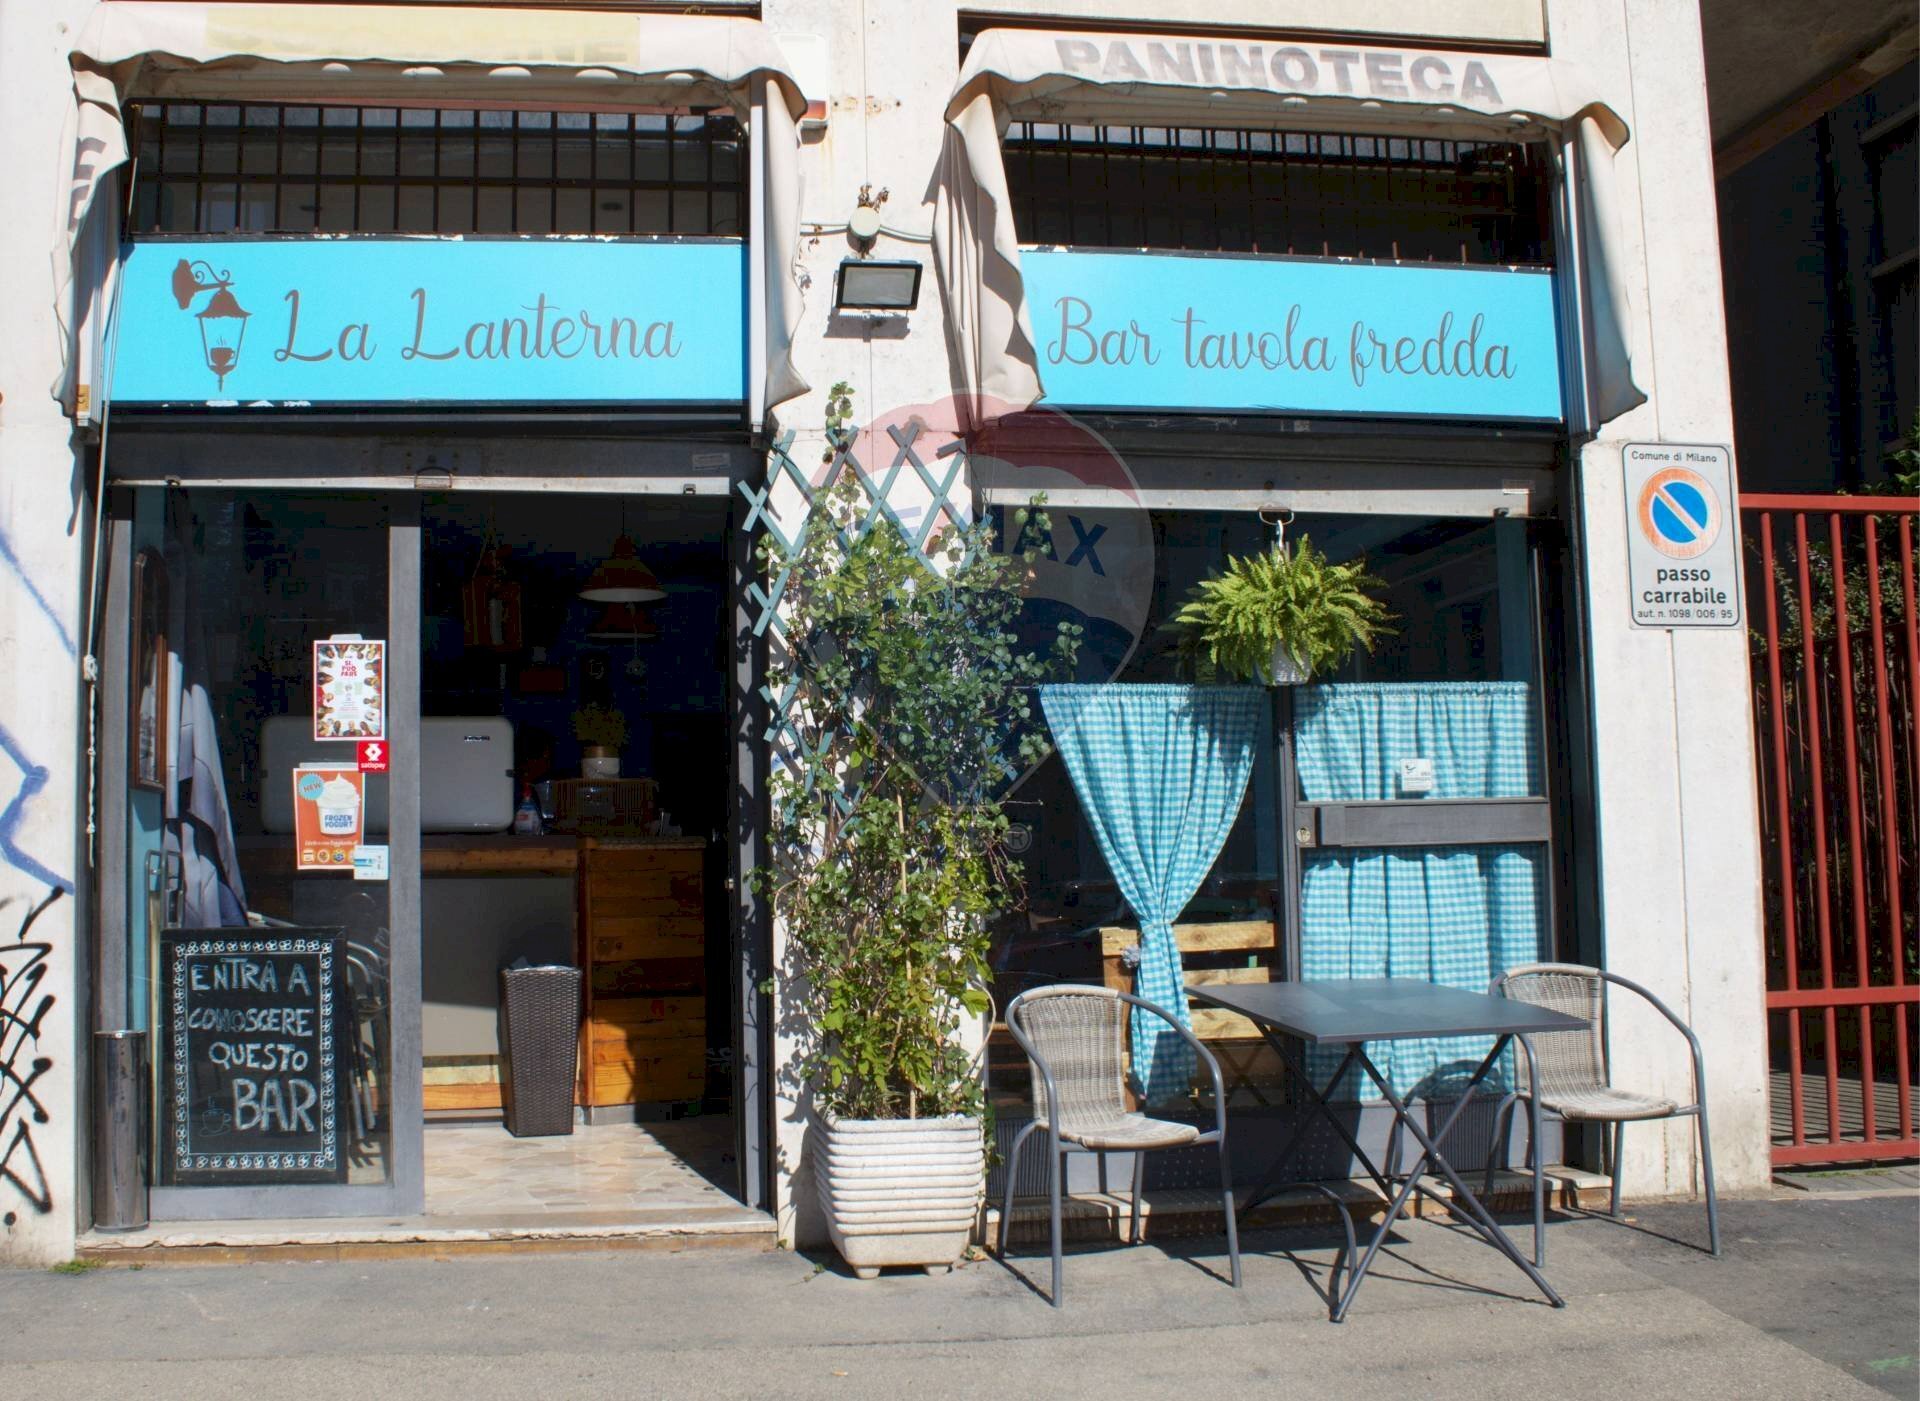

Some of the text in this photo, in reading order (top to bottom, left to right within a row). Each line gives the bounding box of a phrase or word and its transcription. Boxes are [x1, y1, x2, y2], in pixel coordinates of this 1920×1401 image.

[1054, 39, 1503, 104] PANINOTECA
[274, 287, 682, 362] La Lanterna
[1047, 296, 1518, 388] Bar tavola fredda
[1631, 450, 1718, 463] Comune di Milano
[1656, 568, 1711, 584] passo
[1643, 588, 1727, 604] carrabile
[1637, 610, 1655, 619] aut.
[303, 783, 321, 793] NEW
[324, 814, 353, 822] FROZEN
[324, 821, 353, 829] YOGURT
[190, 957, 313, 997] ENTRA A
[188, 1006, 315, 1037] CONOSCERE
[207, 1040, 310, 1072] QUESTO
[231, 1077, 318, 1133] BAR
